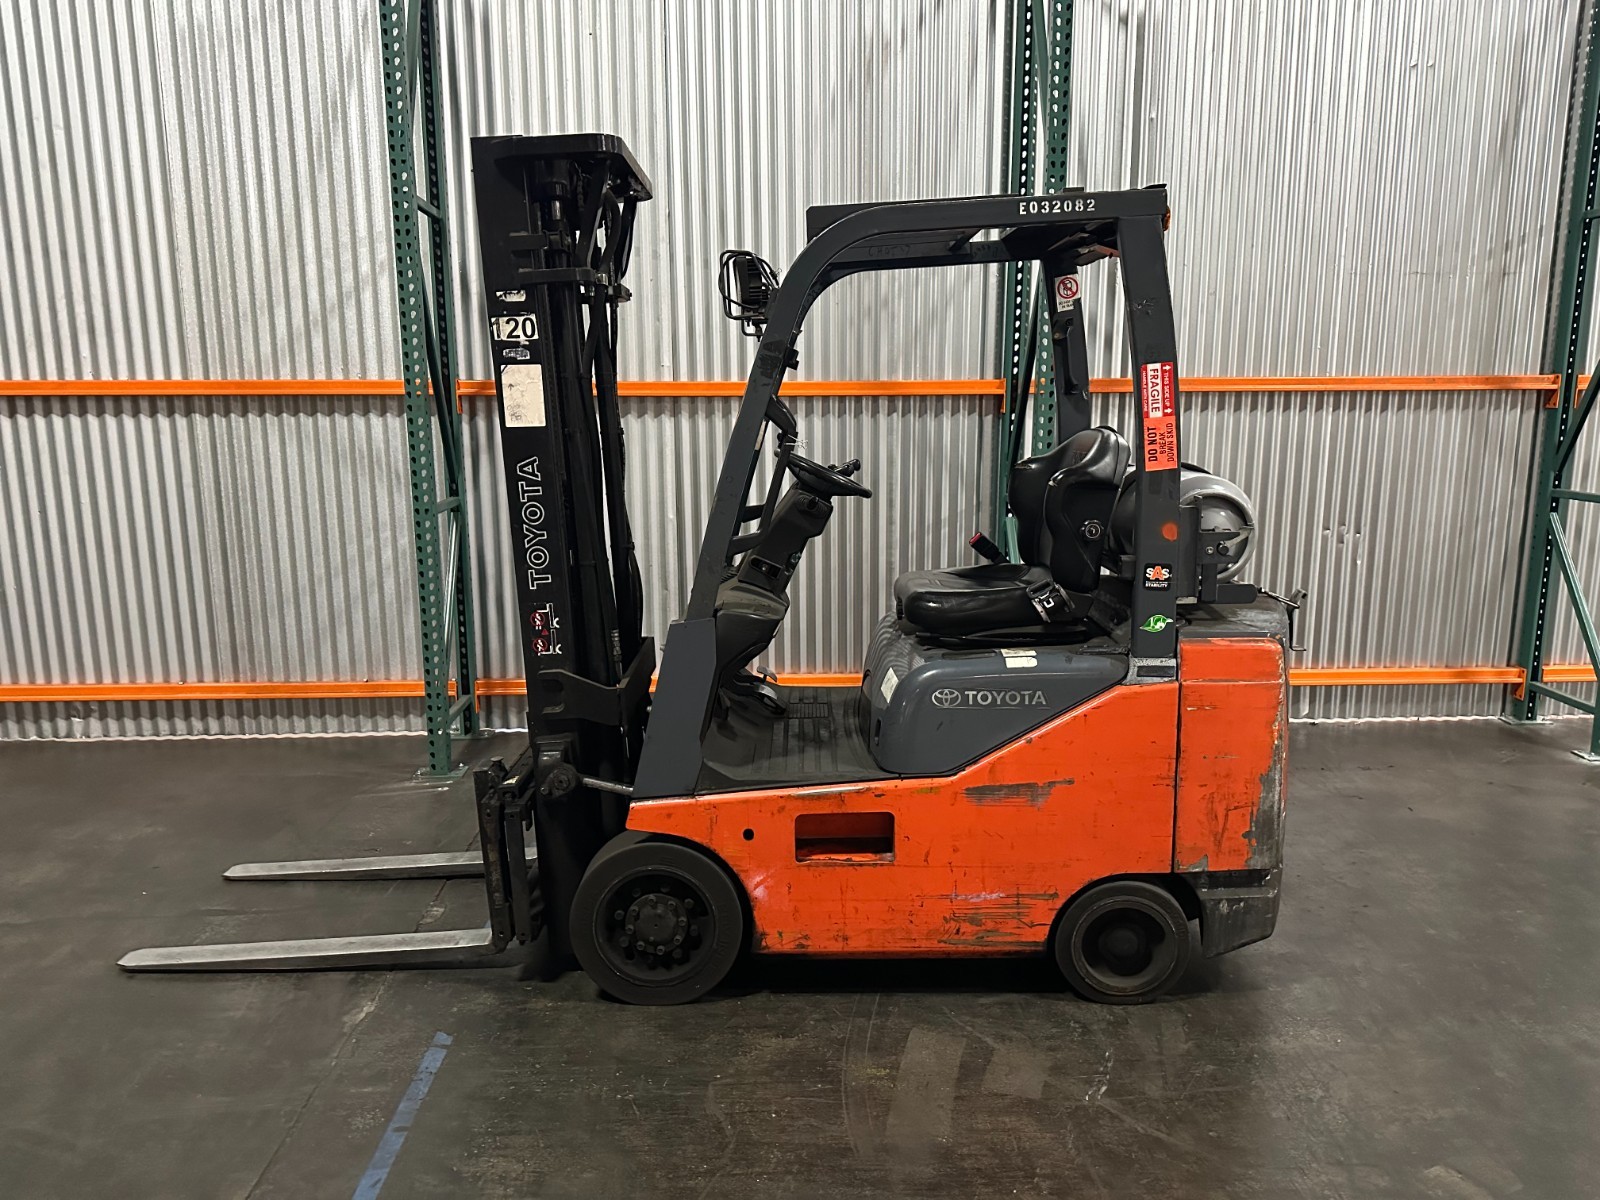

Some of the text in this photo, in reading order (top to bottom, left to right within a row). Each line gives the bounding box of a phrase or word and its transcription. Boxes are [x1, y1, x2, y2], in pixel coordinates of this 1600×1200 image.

[1019, 198, 1096, 215] E032082
[1150, 368, 1161, 413] FRAGILE
[1147, 426, 1158, 462] DO NOT
[1159, 431, 1167, 455] BREAK
[1166, 422, 1175, 462] DOWN SKID
[517, 456, 552, 590] TOYOTA
[1145, 565, 1170, 581] SAS
[964, 690, 1047, 706] TOYOTA
